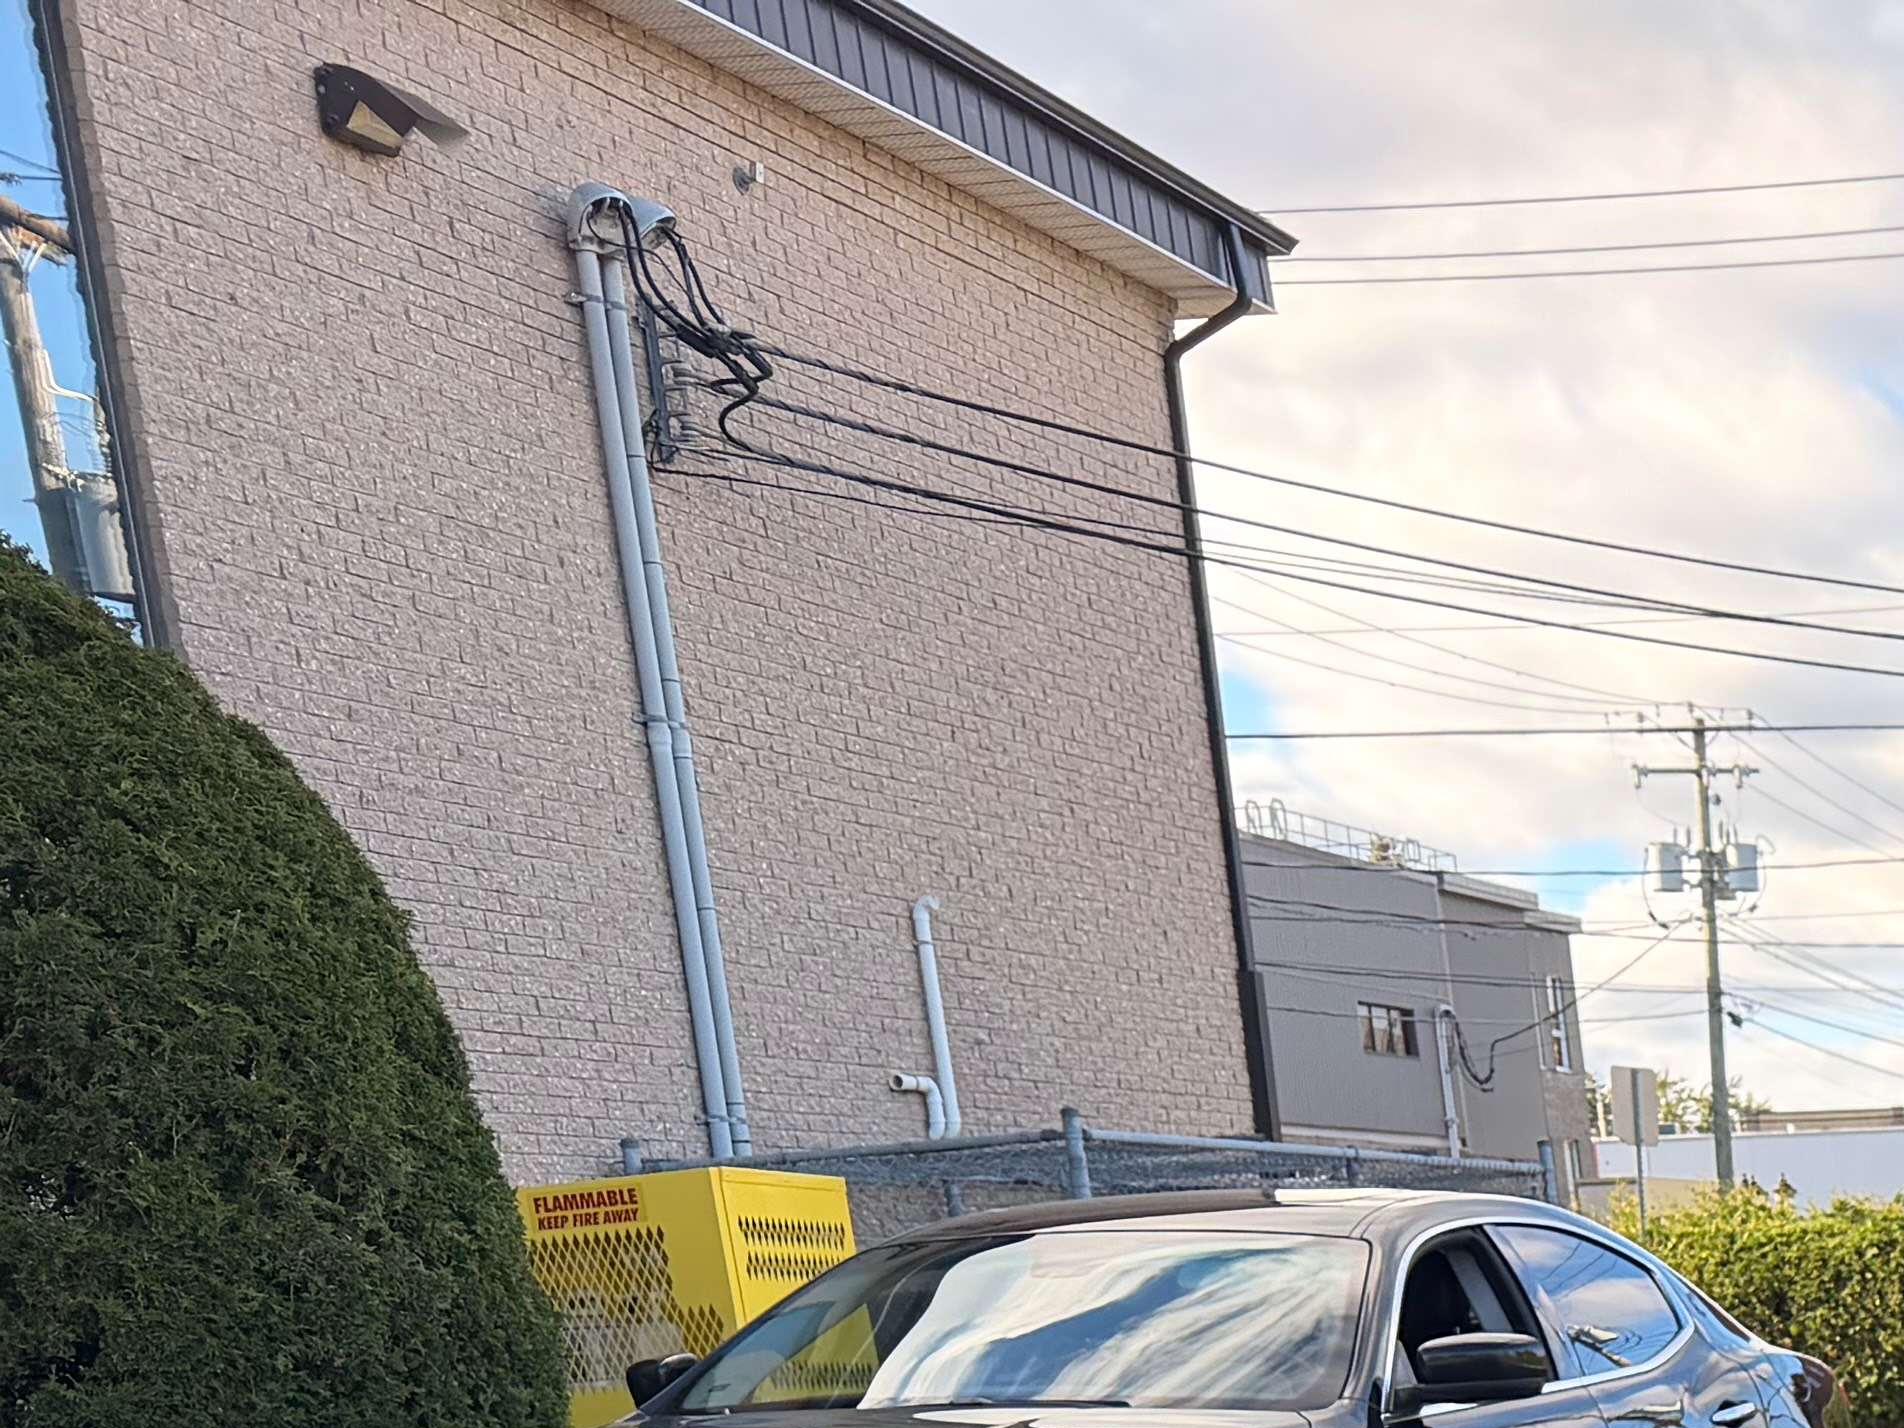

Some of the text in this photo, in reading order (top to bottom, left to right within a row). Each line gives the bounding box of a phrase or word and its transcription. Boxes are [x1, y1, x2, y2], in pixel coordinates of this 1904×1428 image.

[533, 1188, 638, 1214] FLAMMABLE
[538, 1208, 639, 1231] KEEP FIRE AWAY
